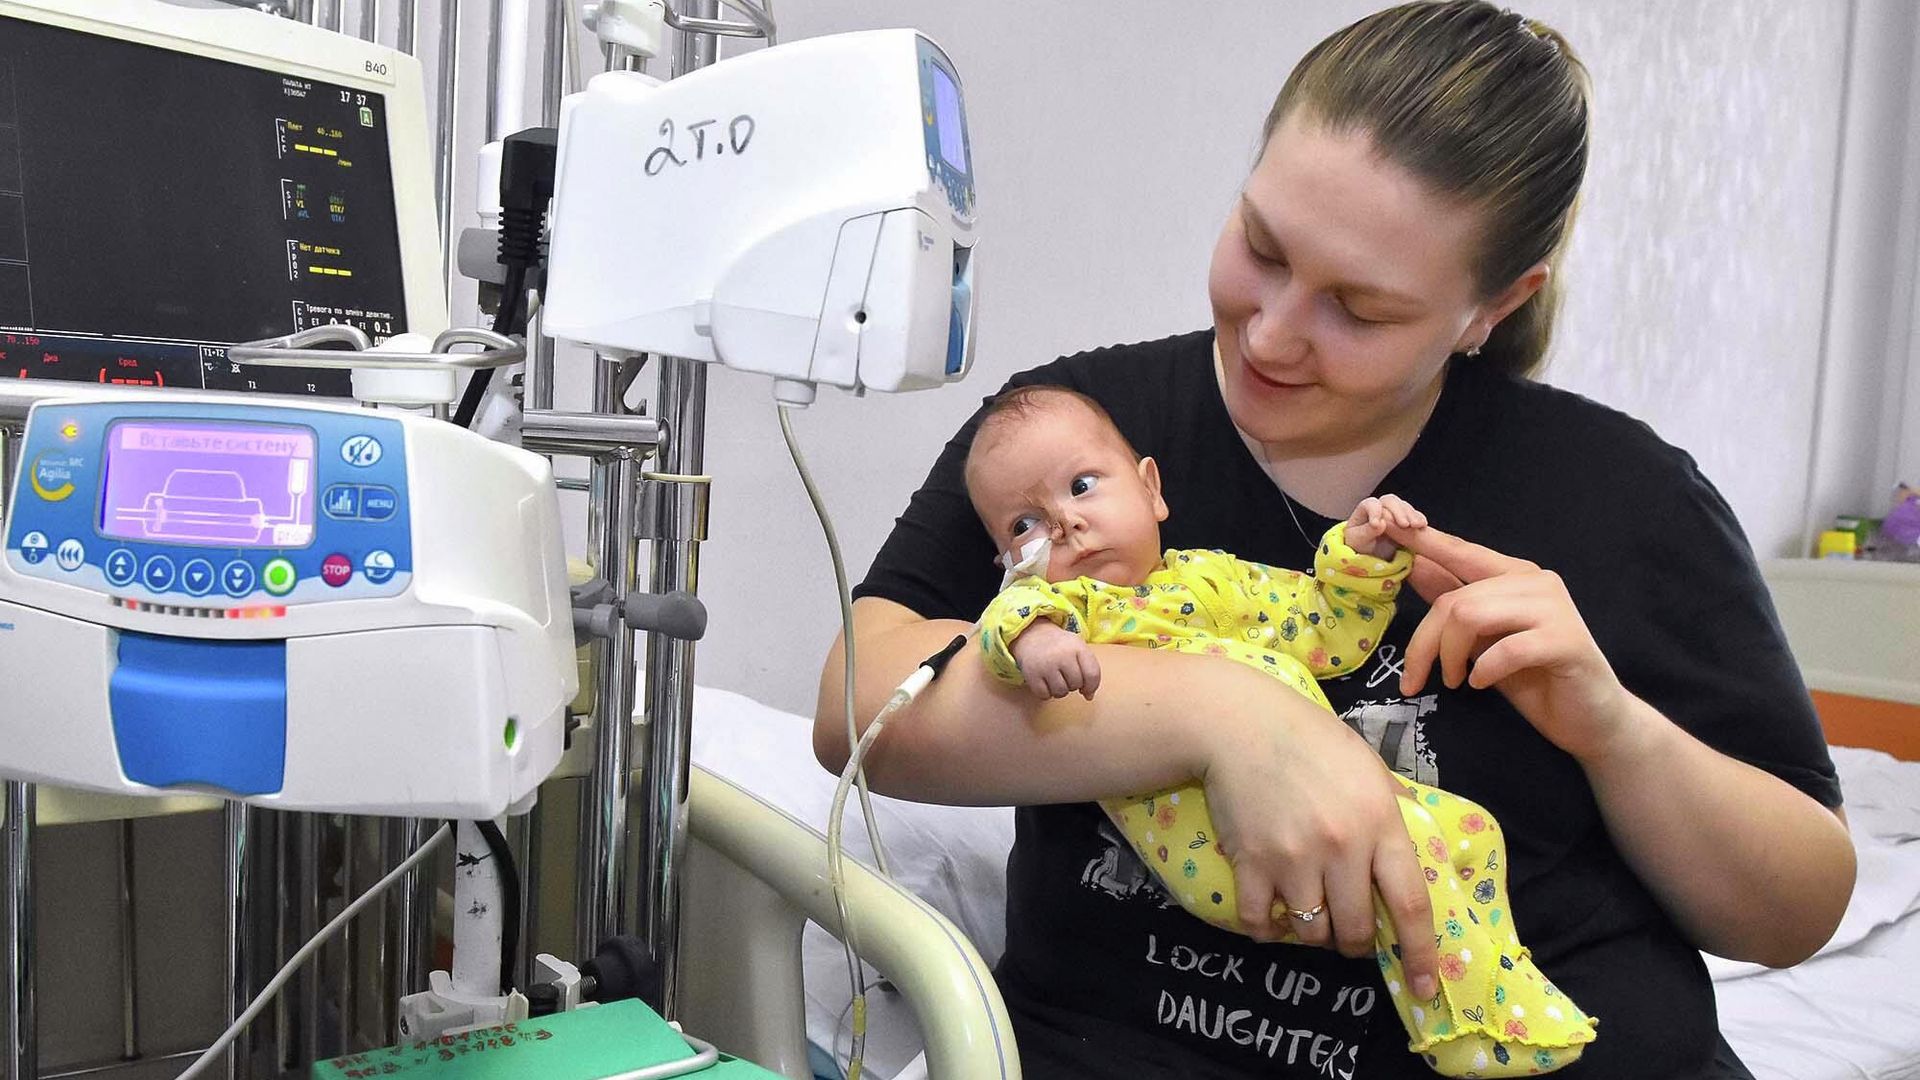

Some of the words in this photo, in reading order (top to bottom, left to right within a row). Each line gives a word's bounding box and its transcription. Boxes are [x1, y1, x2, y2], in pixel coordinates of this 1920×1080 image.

[365, 60, 387, 76] B40
[39, 466, 72, 482] Agilia
[367, 498, 394, 509] MENU
[322, 564, 350, 576] STOP
[1146, 934, 1245, 984] LOCK
[1265, 962, 1321, 1006] UP
[1157, 988, 1360, 1080] DAUGHTERS
